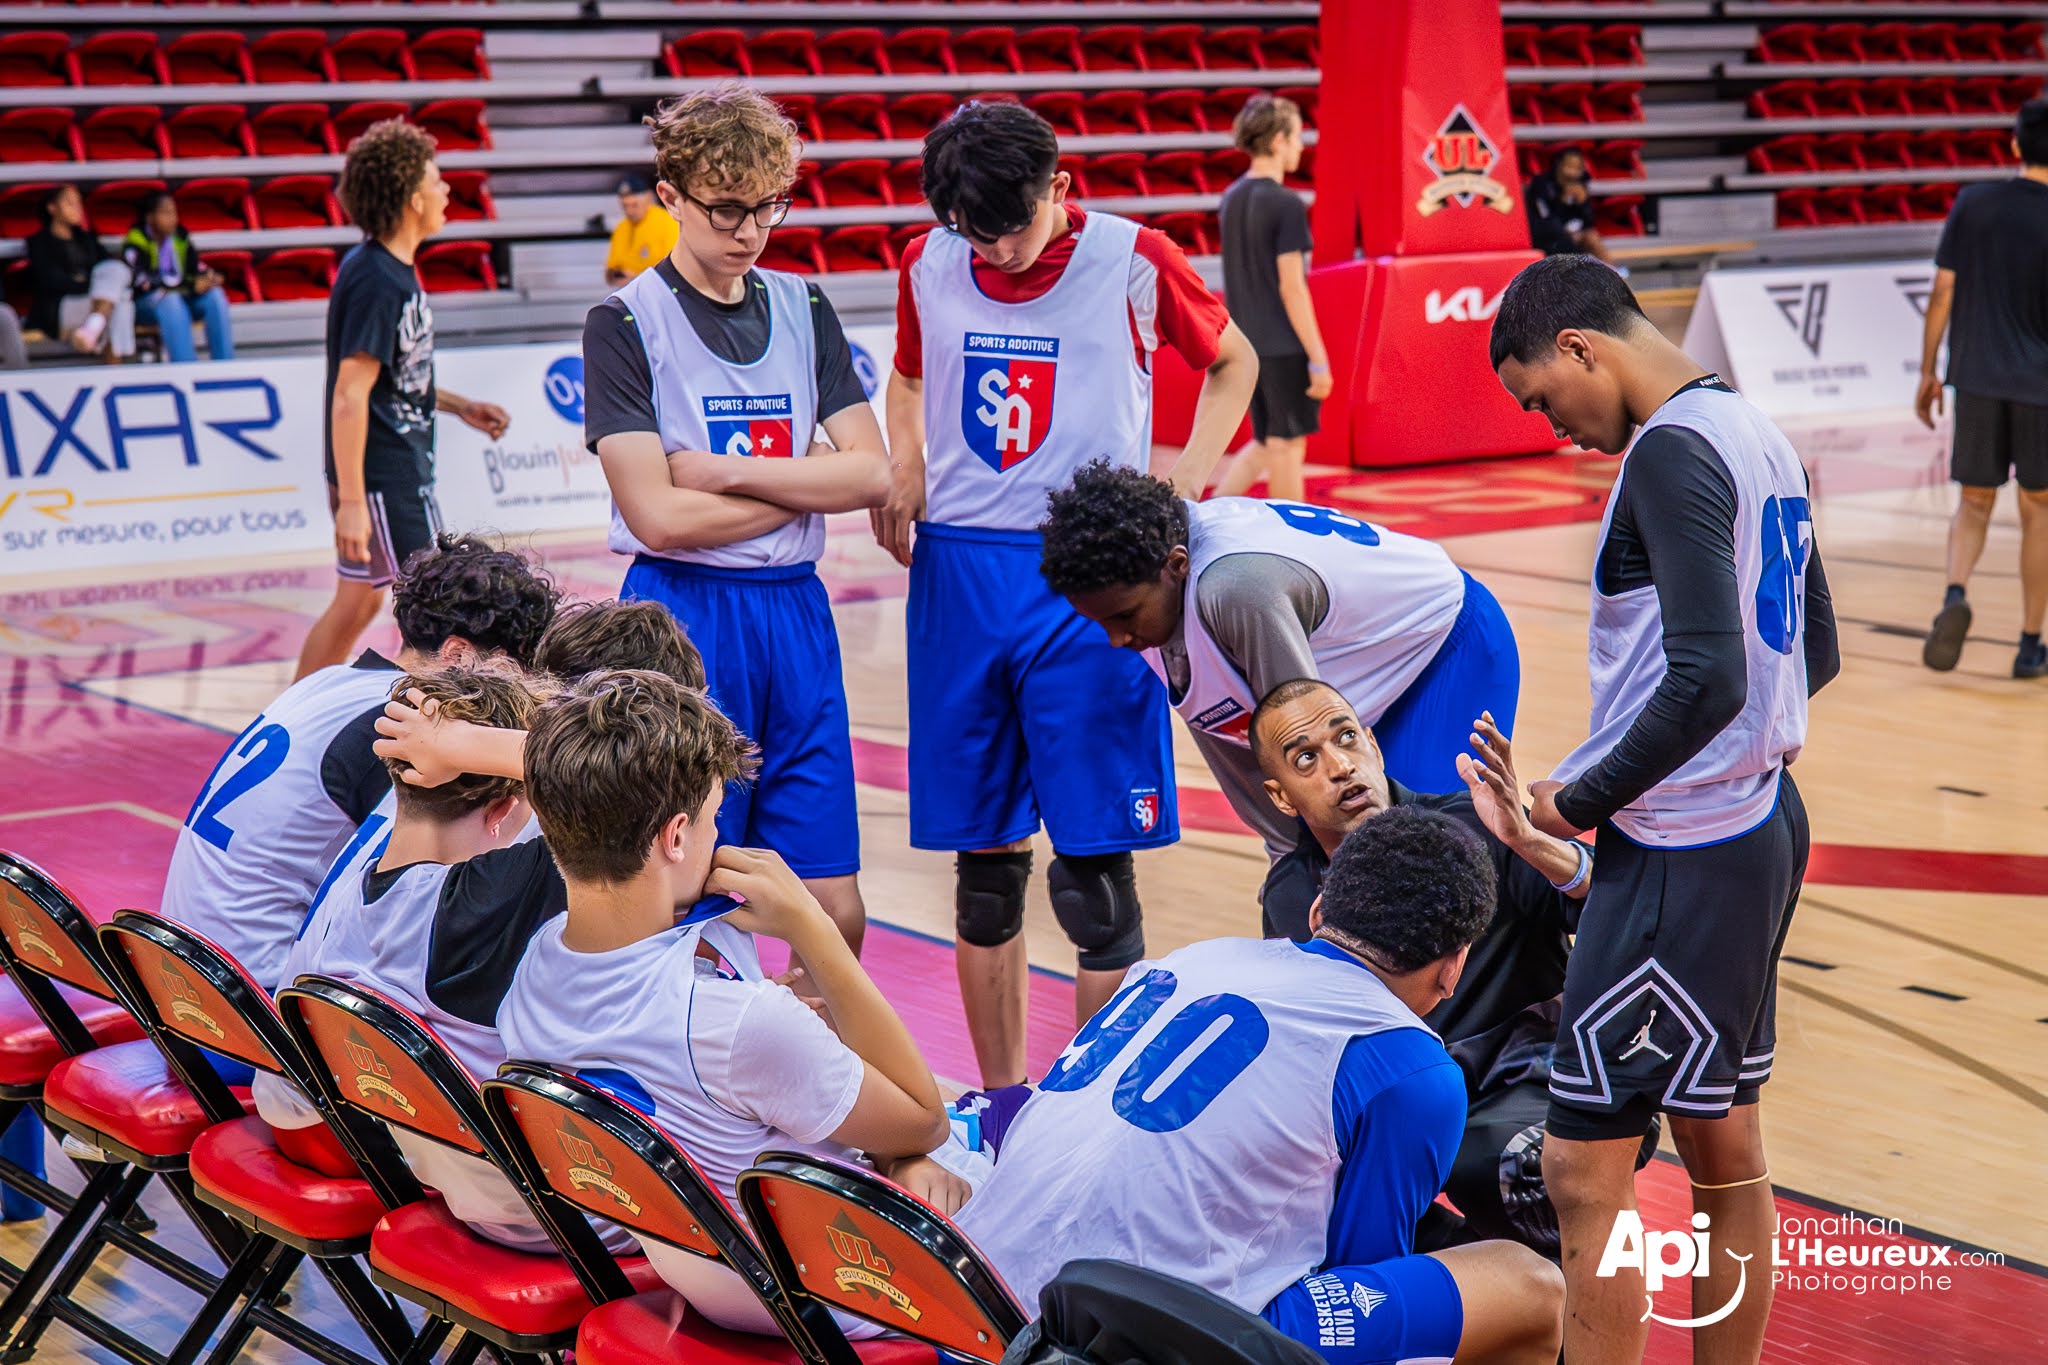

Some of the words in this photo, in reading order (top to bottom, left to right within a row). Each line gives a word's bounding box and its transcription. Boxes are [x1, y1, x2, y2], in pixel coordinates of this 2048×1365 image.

[1433, 132, 1492, 171] UL
[969, 335, 1006, 349] SPORTS
[1008, 338, 1055, 353] ADDITIVE
[1699, 376, 1720, 387] NIKE
[707, 399, 743, 411] SPORTS
[746, 397, 787, 411] ADDITIVE
[3, 528, 48, 551] sur
[172, 512, 235, 541] pour
[240, 508, 307, 533] tous
[1038, 969, 1270, 1133] 90
[556, 1128, 612, 1176] UL
[826, 1225, 891, 1277] UL
[1333, 1308, 1355, 1346] NOVA
